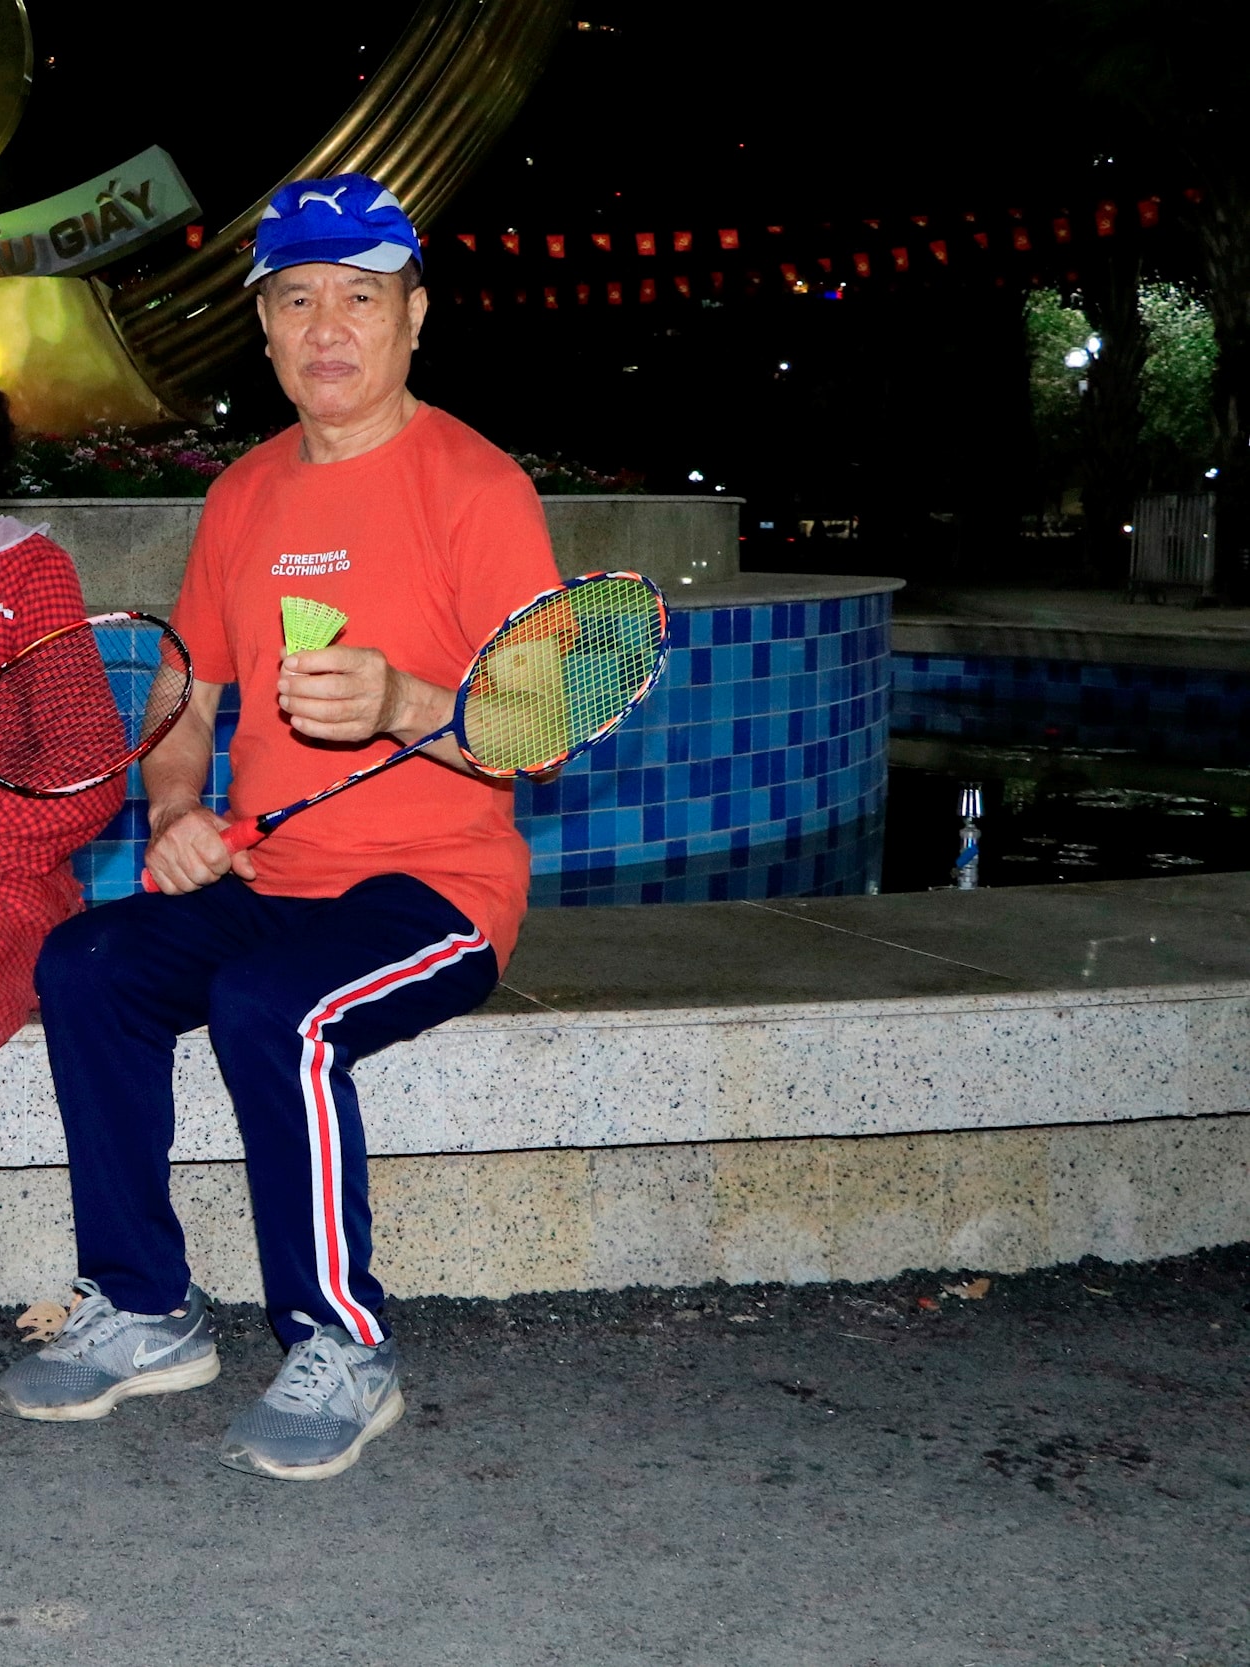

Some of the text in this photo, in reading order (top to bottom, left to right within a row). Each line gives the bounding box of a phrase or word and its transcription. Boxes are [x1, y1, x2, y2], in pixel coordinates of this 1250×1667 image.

[48, 179, 154, 260] GIẤY
[279, 549, 347, 565] STREETWEAR
[271, 560, 351, 576] CLOTHING & CO
